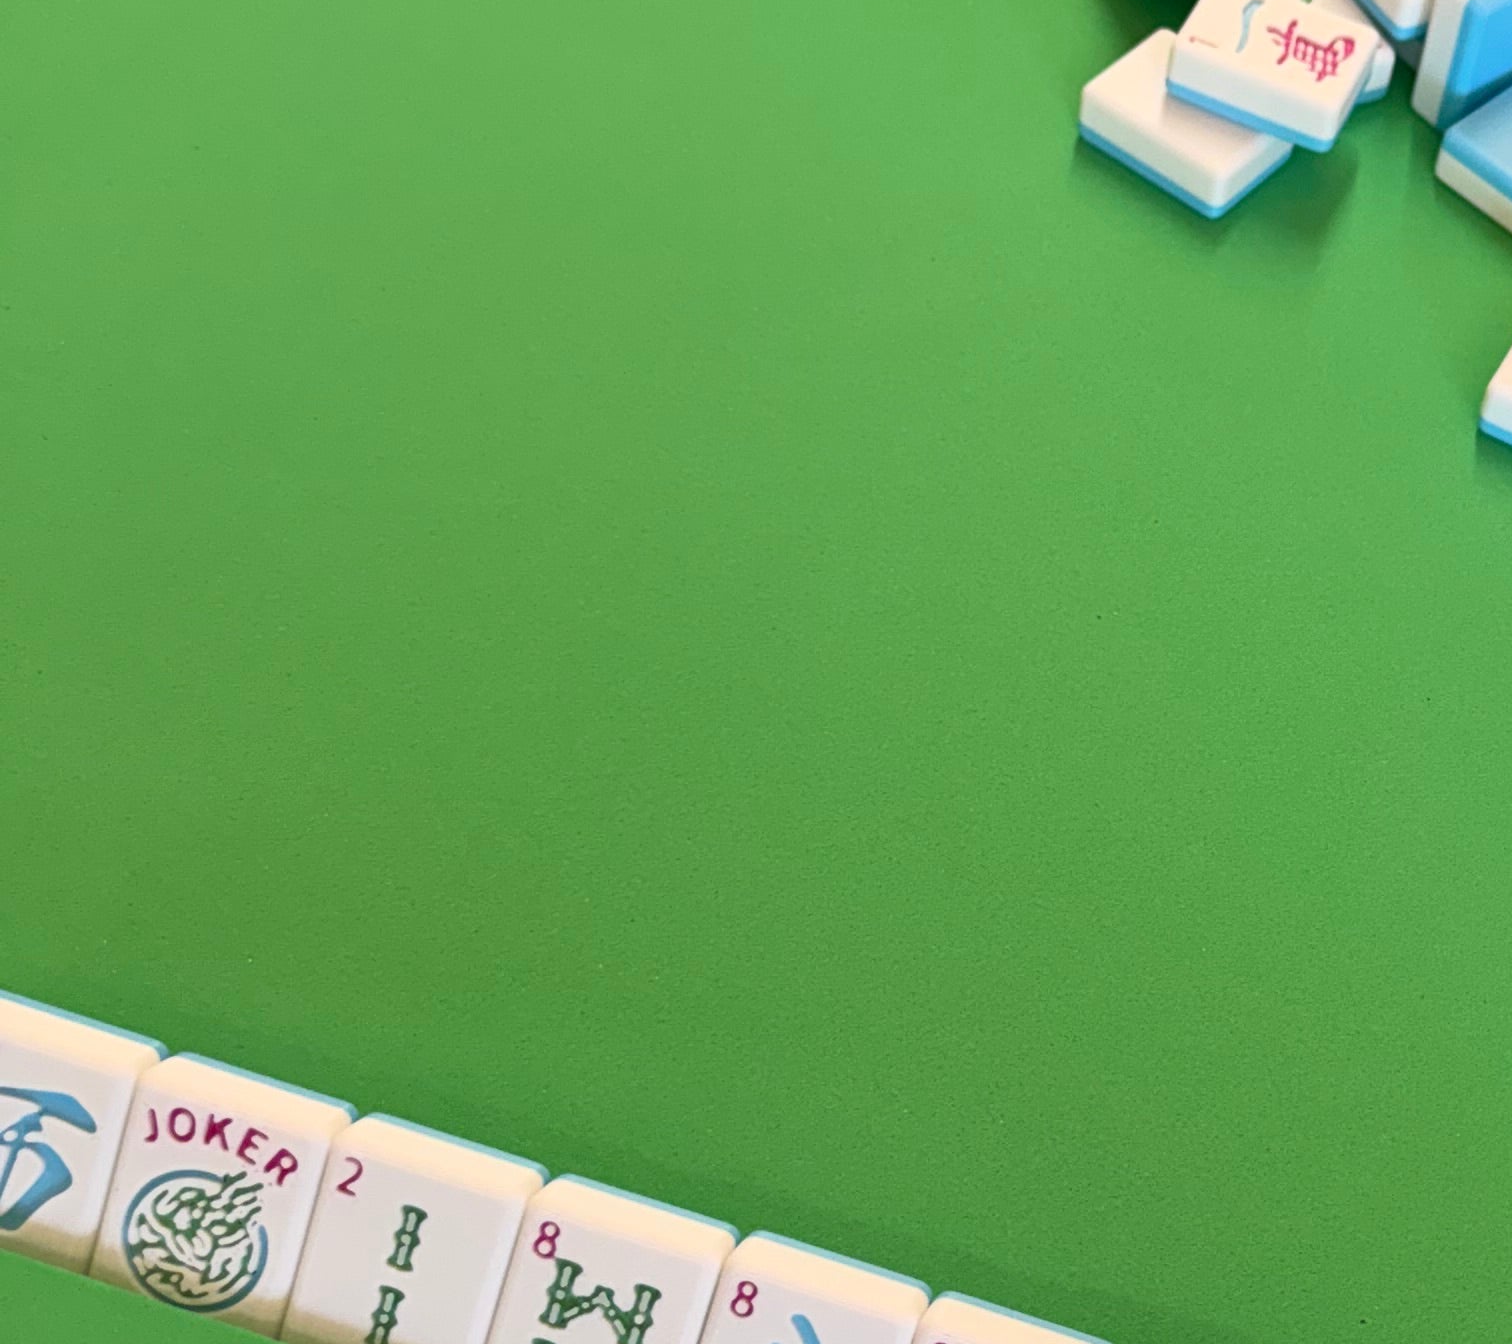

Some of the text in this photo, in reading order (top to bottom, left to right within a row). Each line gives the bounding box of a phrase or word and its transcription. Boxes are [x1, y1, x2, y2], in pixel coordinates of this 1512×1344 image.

[144, 1106, 299, 1187] JOKER
[336, 1156, 364, 1198] 2
[532, 1220, 561, 1259] 8
[730, 1280, 758, 1318] 8
